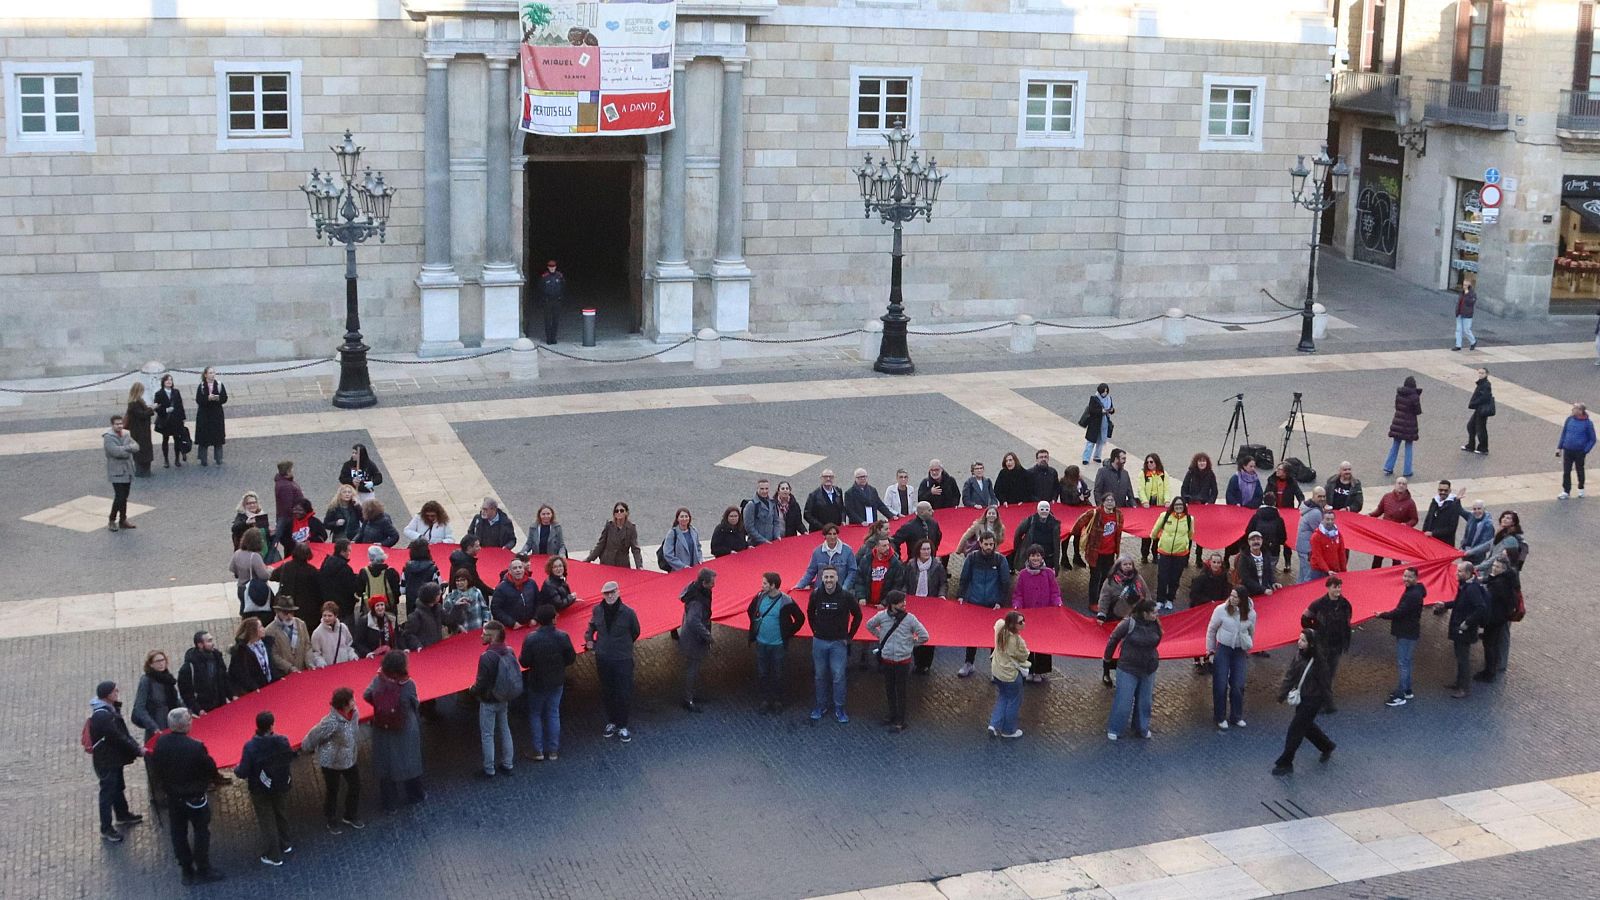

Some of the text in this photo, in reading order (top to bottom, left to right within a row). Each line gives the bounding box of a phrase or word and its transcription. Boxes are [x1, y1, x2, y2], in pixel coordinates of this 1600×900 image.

[558, 106, 572, 117] ELLS
[621, 102, 657, 113] A DAVID
